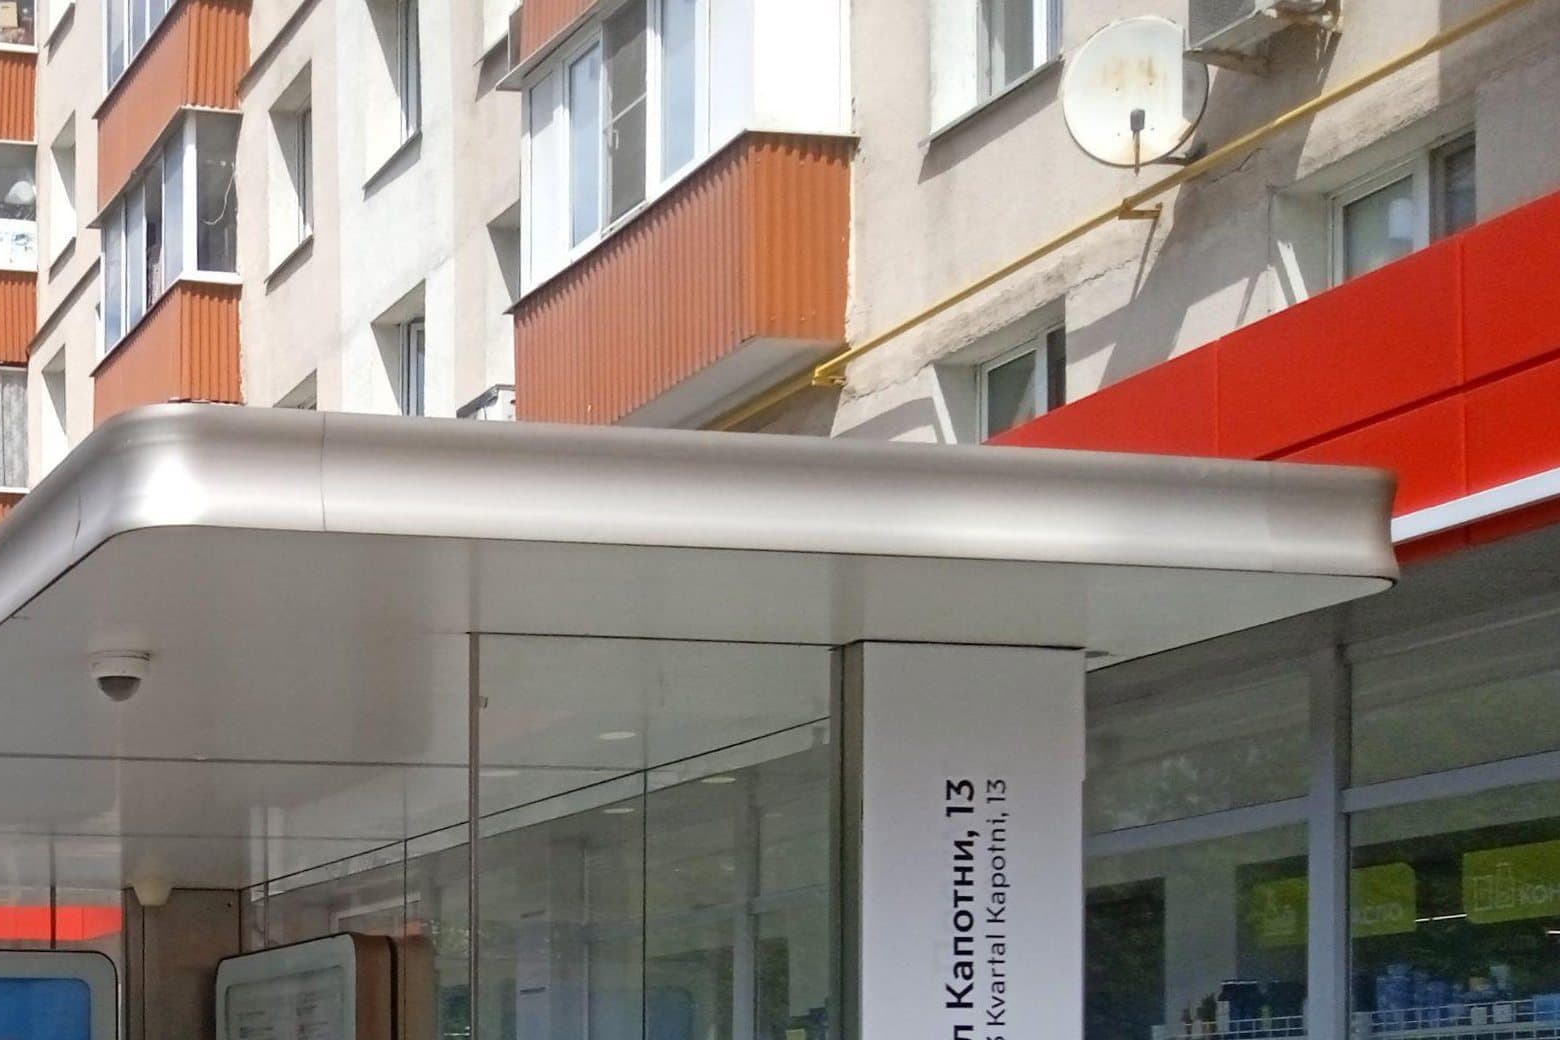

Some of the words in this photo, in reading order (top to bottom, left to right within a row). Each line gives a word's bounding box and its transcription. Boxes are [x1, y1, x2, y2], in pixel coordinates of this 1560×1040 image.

[945, 779, 975, 818] 13
[986, 778, 1006, 804] 13
[985, 812, 1010, 924] Kapotni,
[945, 830, 980, 1009] Капотни,
[985, 934, 1006, 1026] Kvartal
